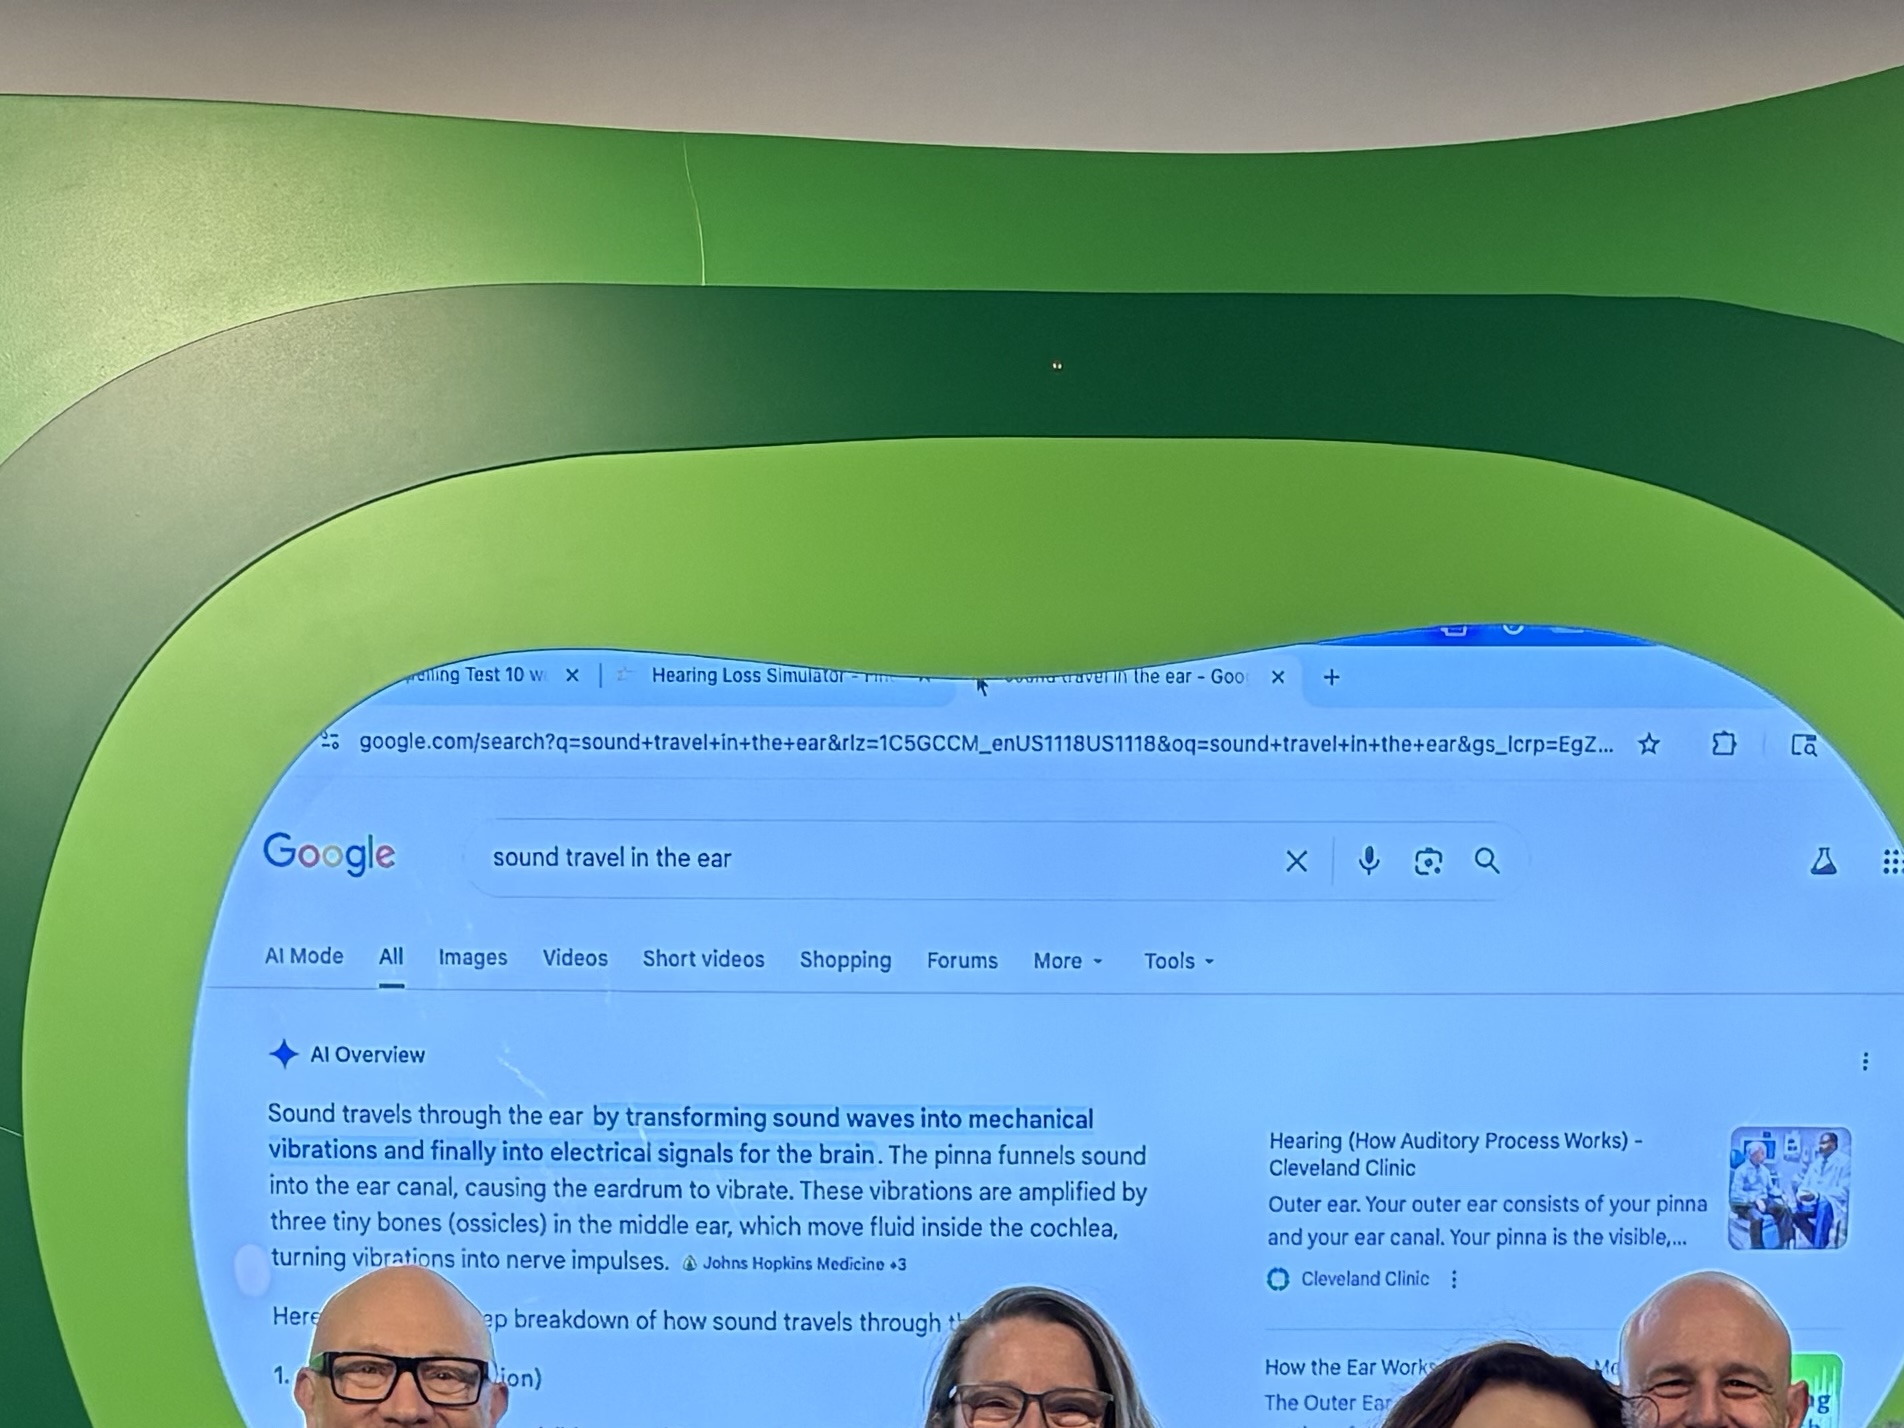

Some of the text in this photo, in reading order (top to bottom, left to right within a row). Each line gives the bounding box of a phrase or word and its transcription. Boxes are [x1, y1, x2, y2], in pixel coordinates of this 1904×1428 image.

[652, 666, 718, 687] Hearing
[768, 668, 844, 683] Simulator
[263, 832, 395, 878] Google
[493, 845, 733, 868] sound travel the ear
[290, 945, 344, 965] Mode
[439, 948, 508, 970] Images
[542, 947, 609, 967] Videos
[643, 948, 765, 968] Short videos
[800, 949, 892, 974] Shopping
[927, 951, 999, 970] Forums
[1034, 952, 1083, 970] More
[1144, 950, 1196, 970] Tools
[335, 1045, 426, 1064] Overview
[268, 1101, 1094, 1133] Sound travels through the ear by transforming sound waves into mechanical
[1270, 1130, 1629, 1154] Hearing Auditory Process Works)
[268, 1137, 1147, 1170] vibrations and finally into electrical signals for the brain. The pinna funnels sound
[1269, 1157, 1416, 1177] Cleveland Clinic
[269, 1173, 1148, 1207] into the ear canal, causing the eardrum vibrate. These vibrations are amplified by
[1268, 1193, 1708, 1217] Outer outer consists pinna
[270, 1209, 1118, 1241] three tiny bones (ossicles) the middle which move fluid inside the cochlea,
[1390, 1227, 1547, 1250] canal. pinna
[271, 1245, 885, 1275] turning into nerve impulses. Johns Hopkins Medicine
[1301, 1269, 1430, 1287] Cleveland Clinic
[514, 1307, 629, 1330] breakdown
[664, 1308, 708, 1331] how
[712, 1309, 777, 1331] sound
[783, 1310, 853, 1332] travels
[859, 1311, 942, 1338] through
[1347, 1358, 1377, 1376] Ear
[1303, 1394, 1392, 1412] Outer Ear
